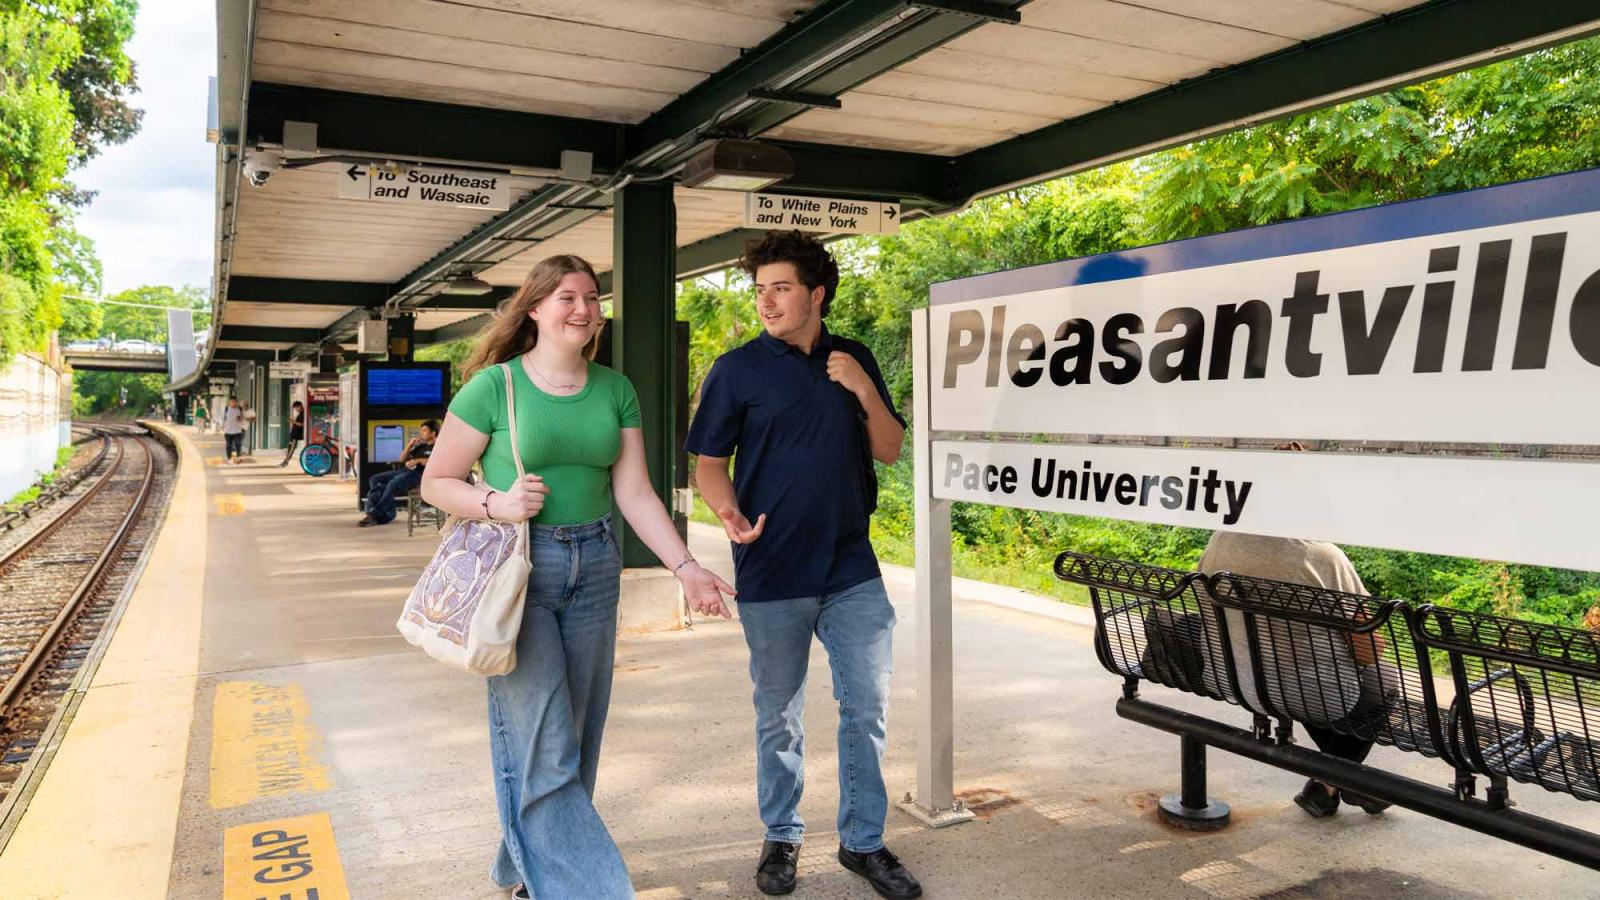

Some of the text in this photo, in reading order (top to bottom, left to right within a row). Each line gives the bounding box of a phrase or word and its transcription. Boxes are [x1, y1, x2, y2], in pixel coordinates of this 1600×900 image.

[407, 170, 498, 190] Southeast
[374, 186, 490, 205] and Wassaic
[757, 196, 869, 216] To White Plains
[756, 213, 858, 229] and New York
[943, 453, 1253, 525] Pace University
[252, 830, 314, 884] GAP
